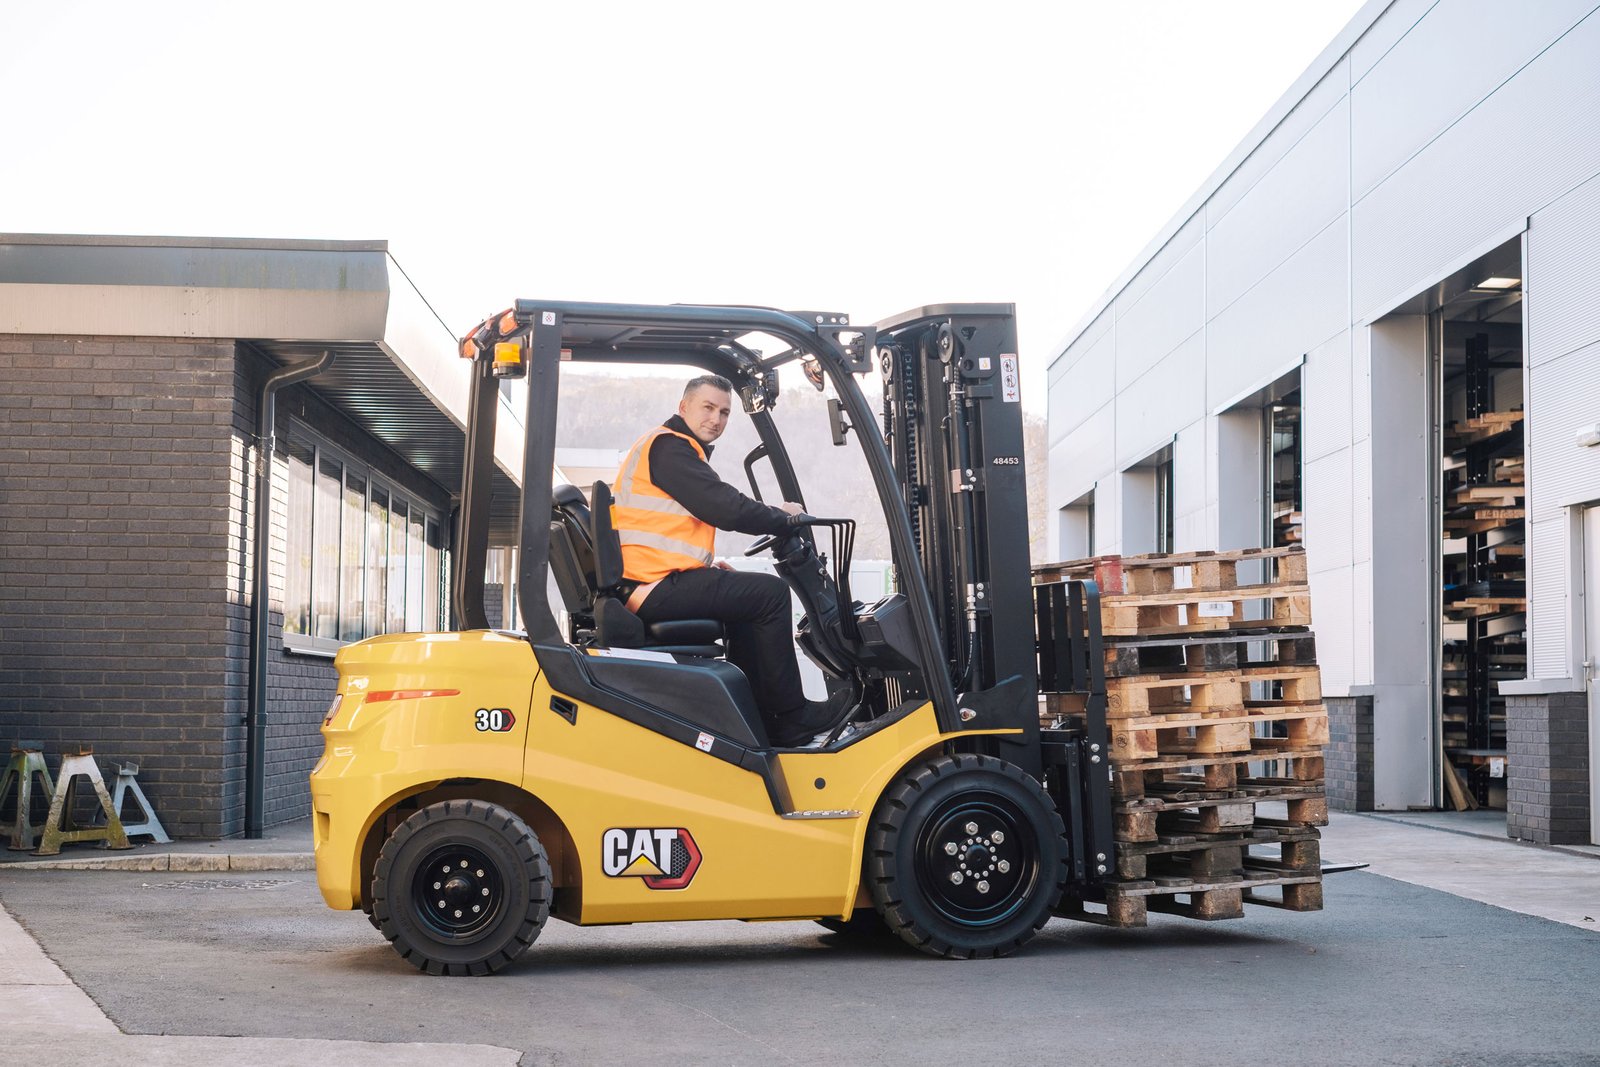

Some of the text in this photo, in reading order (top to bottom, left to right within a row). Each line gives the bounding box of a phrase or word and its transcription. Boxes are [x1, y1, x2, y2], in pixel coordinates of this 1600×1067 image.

[993, 457, 1019, 465] 48453
[476, 709, 503, 731] 30
[603, 828, 678, 876] CAT
